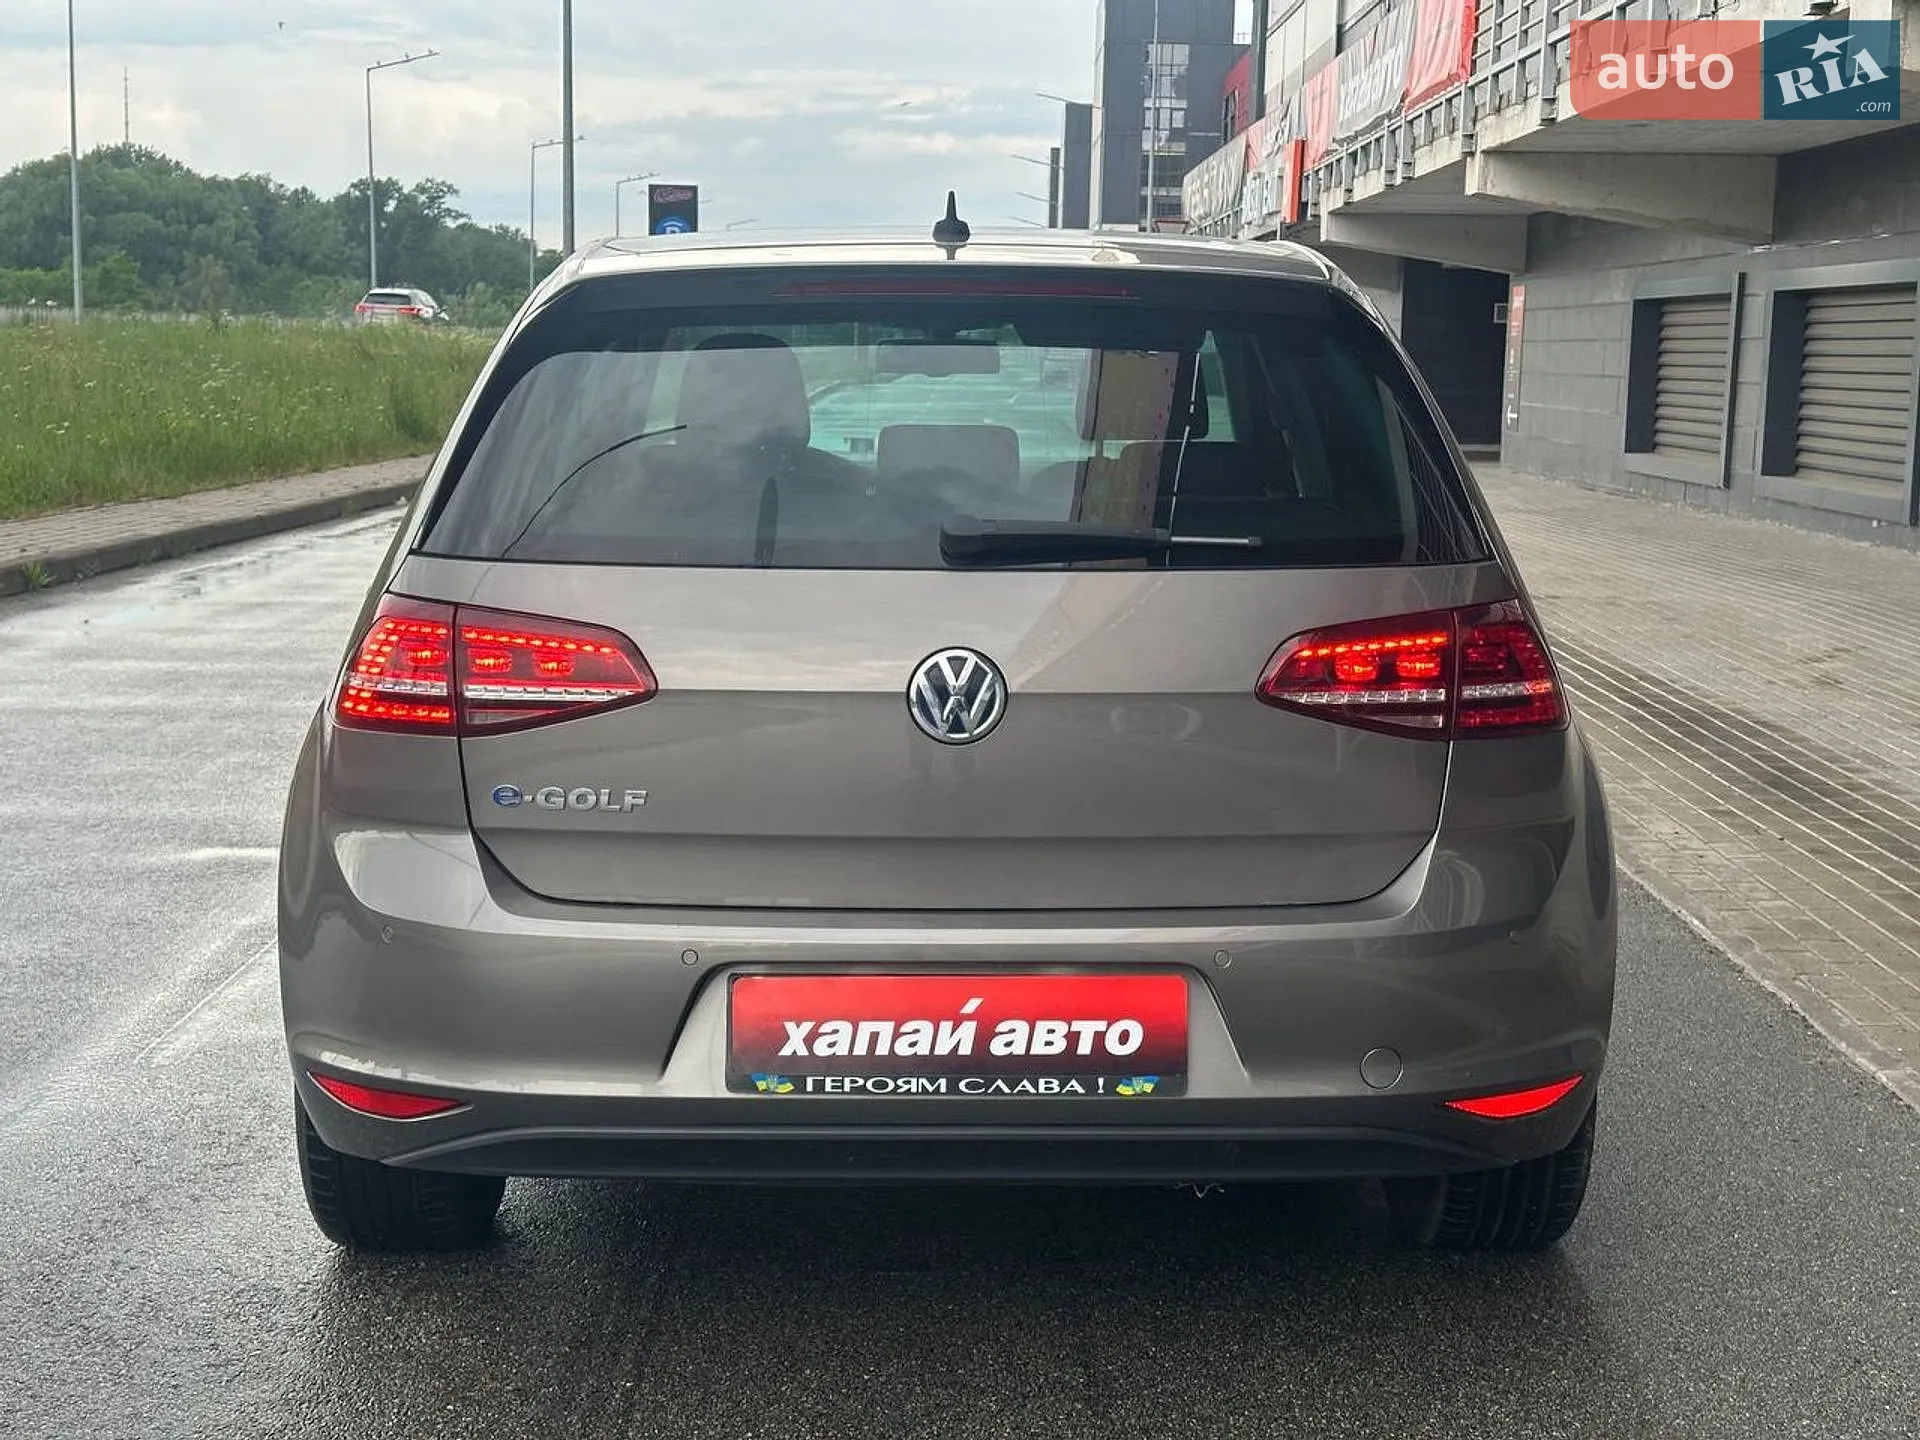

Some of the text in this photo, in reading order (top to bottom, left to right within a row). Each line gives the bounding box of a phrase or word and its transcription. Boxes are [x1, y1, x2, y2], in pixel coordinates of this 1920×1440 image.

[491, 783, 648, 813] e-GOLF
[778, 997, 1144, 1057] хапай авто
[805, 1075, 947, 1094] ГЕРОЯМ
[958, 1076, 1086, 1094] СЛАВА
